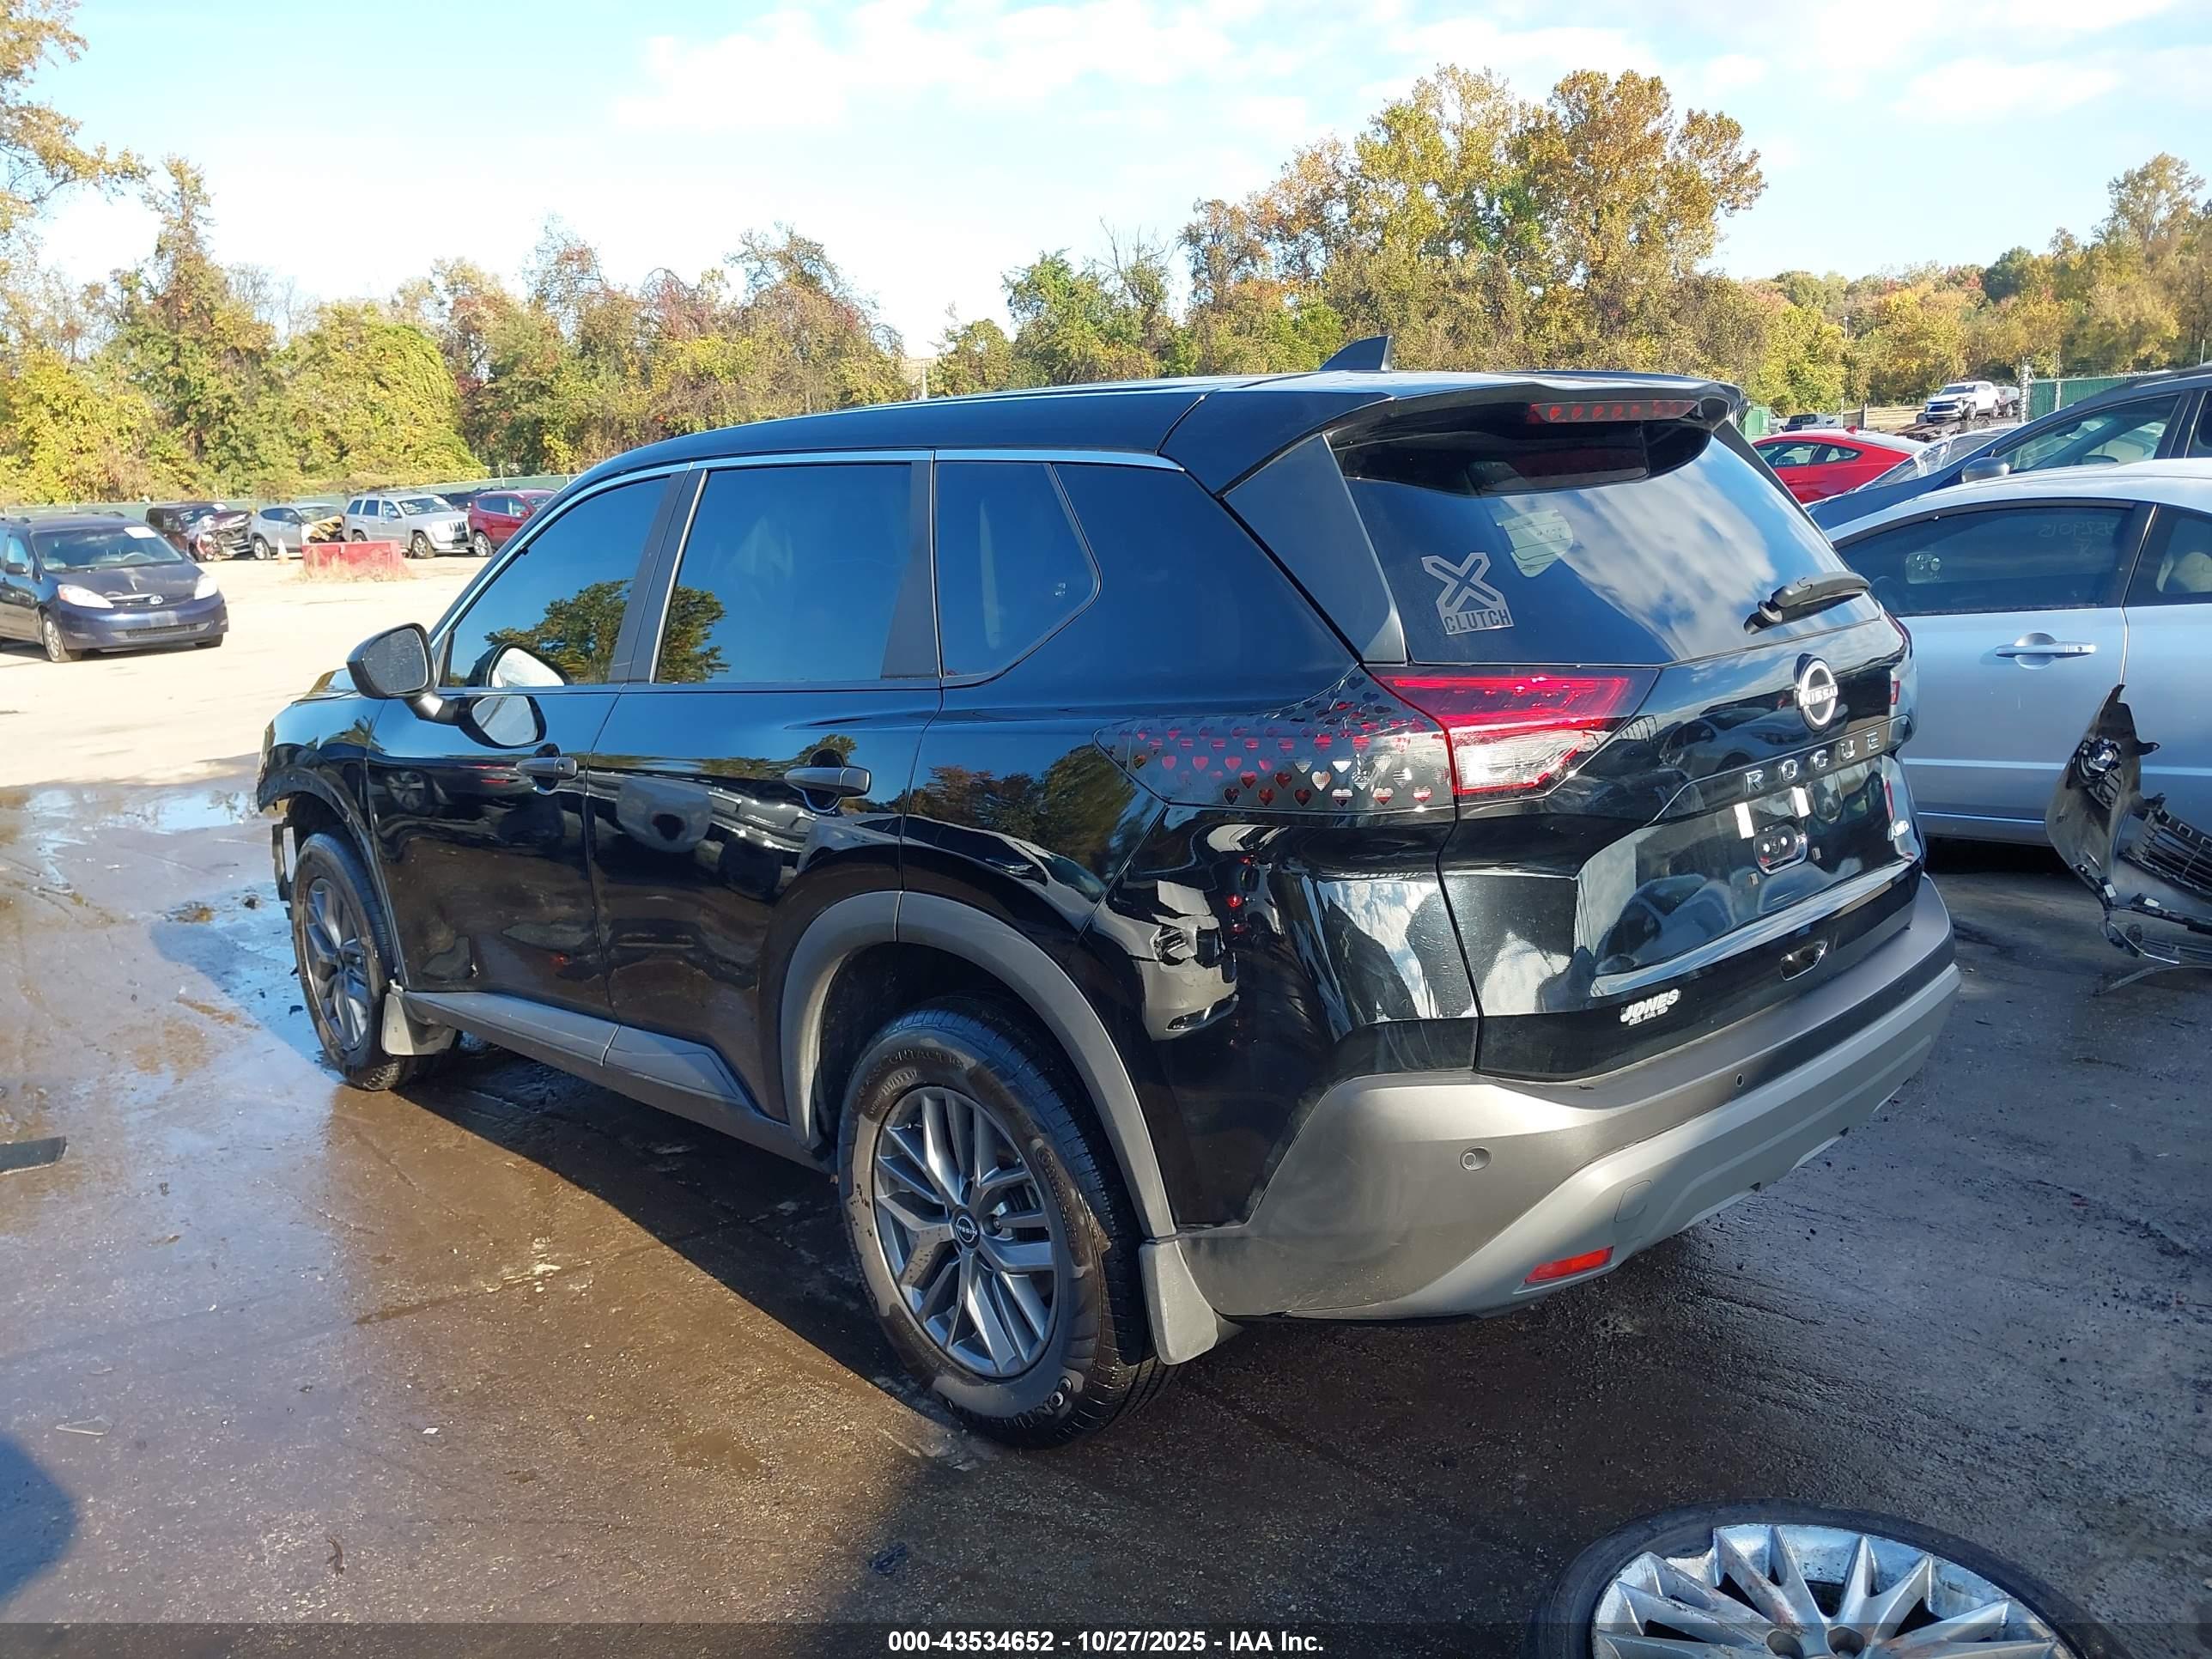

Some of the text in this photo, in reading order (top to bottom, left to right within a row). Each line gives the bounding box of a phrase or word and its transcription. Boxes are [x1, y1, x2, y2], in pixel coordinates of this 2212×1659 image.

[1444, 609, 1511, 632] CLUTCH
[1801, 684, 1838, 706] NISSAN
[1745, 732, 1880, 793] ROGUE
[1620, 988, 1680, 1022] JONES
